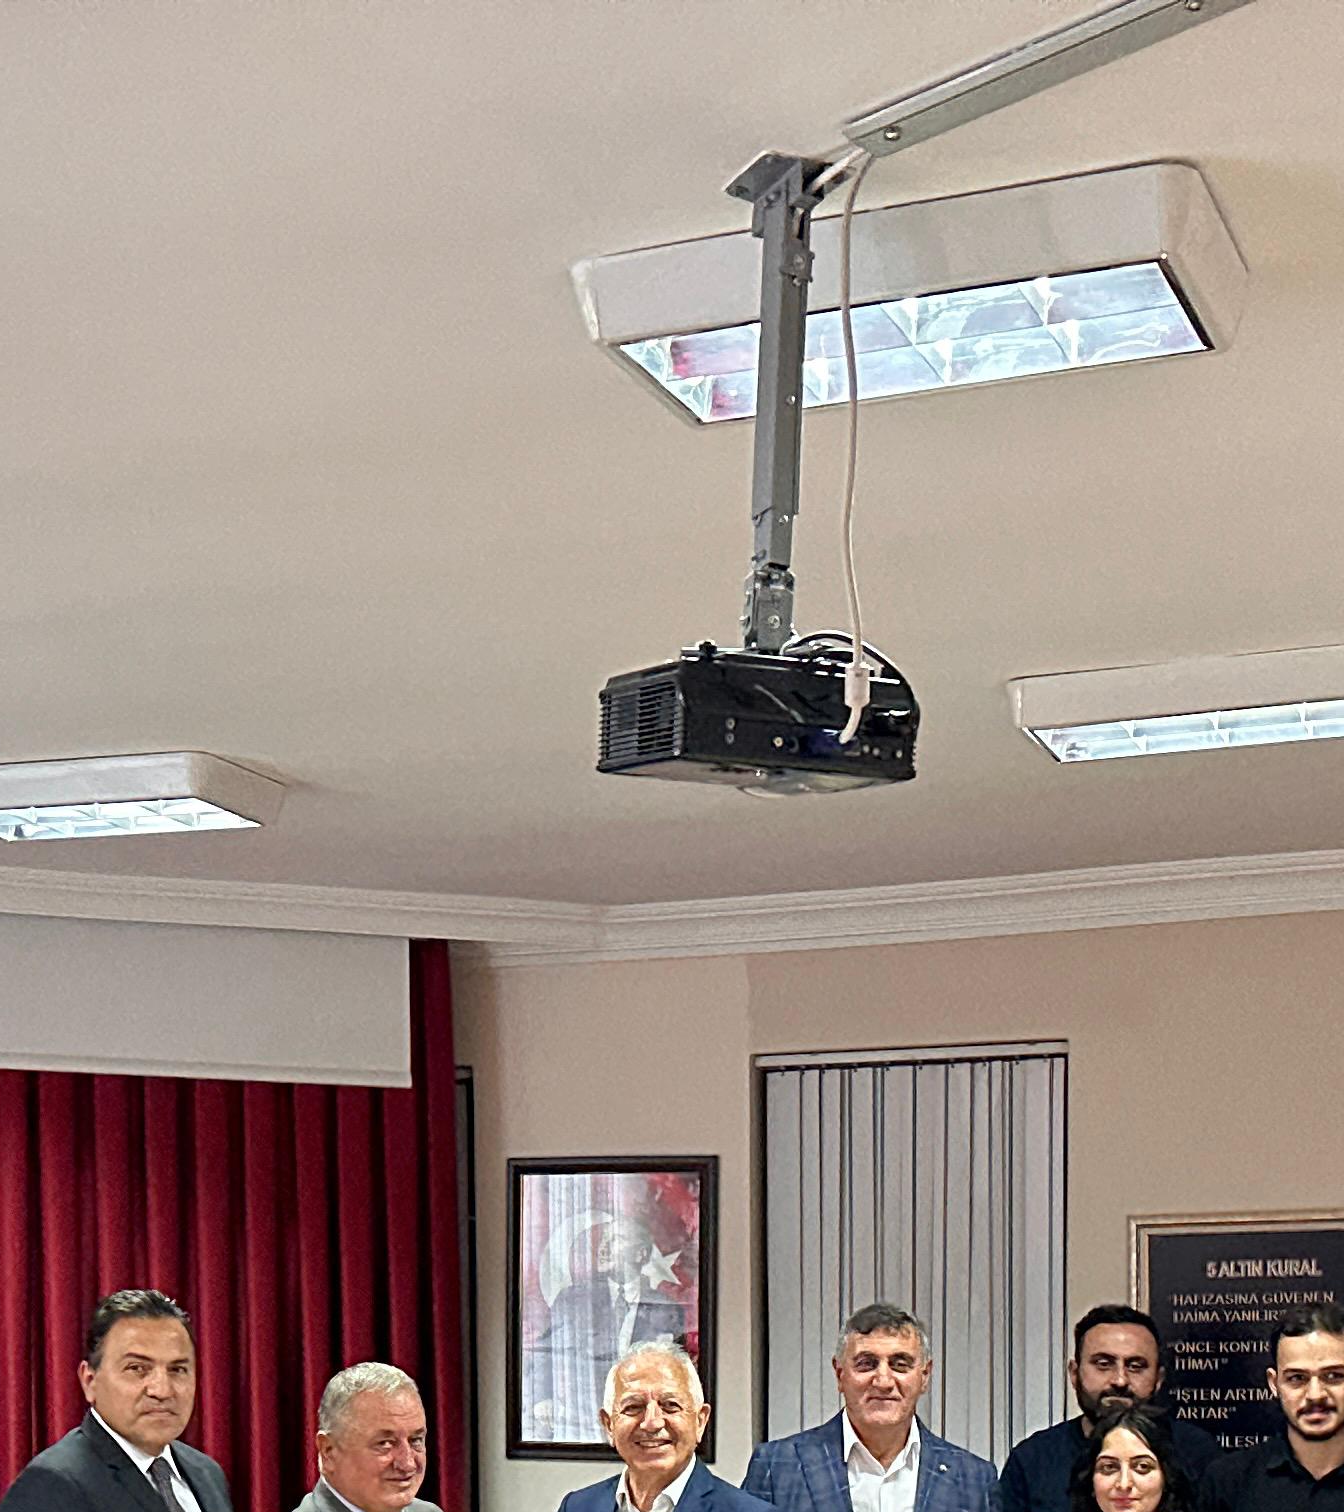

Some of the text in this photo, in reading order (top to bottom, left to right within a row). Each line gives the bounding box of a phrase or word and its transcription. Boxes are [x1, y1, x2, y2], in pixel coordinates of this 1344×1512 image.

[1206, 1258, 1323, 1278] 5 ALTIN KURAL
[1172, 1310, 1220, 1324] DAİMA
